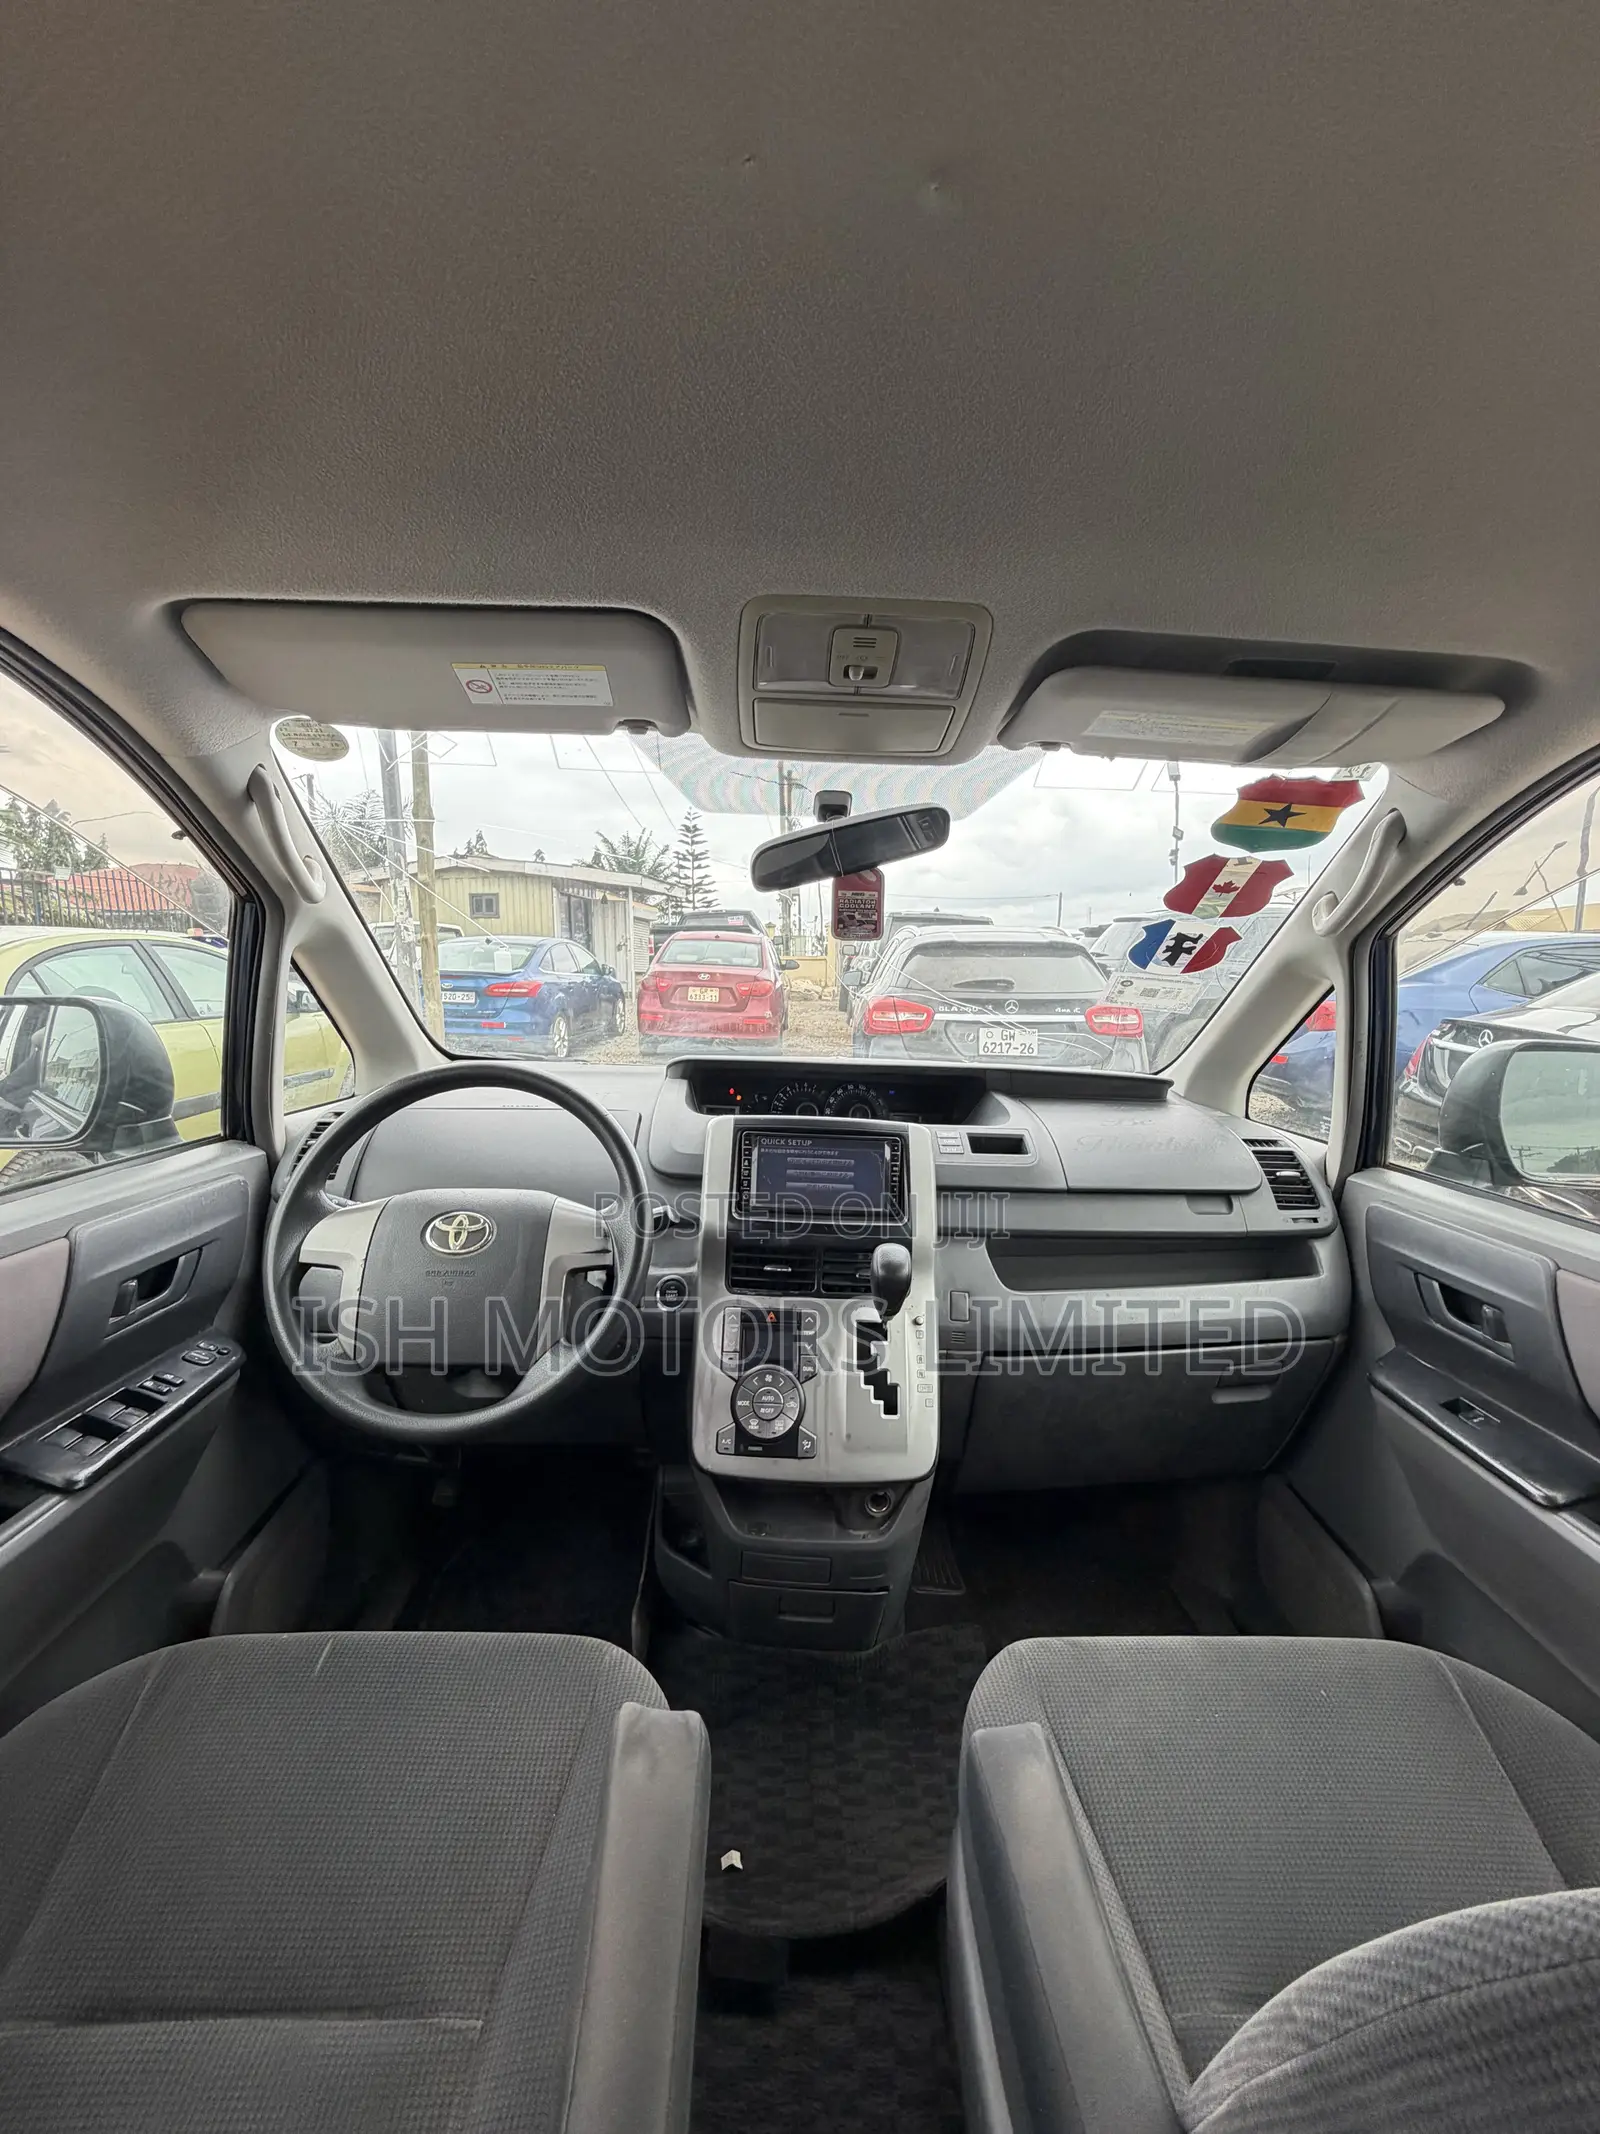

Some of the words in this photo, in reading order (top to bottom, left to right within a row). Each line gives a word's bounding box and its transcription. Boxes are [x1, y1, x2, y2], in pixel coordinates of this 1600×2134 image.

[982, 1042, 1035, 1054] 6217-26
[760, 1138, 786, 1146] QUICK
[787, 1139, 813, 1147] SETUP
